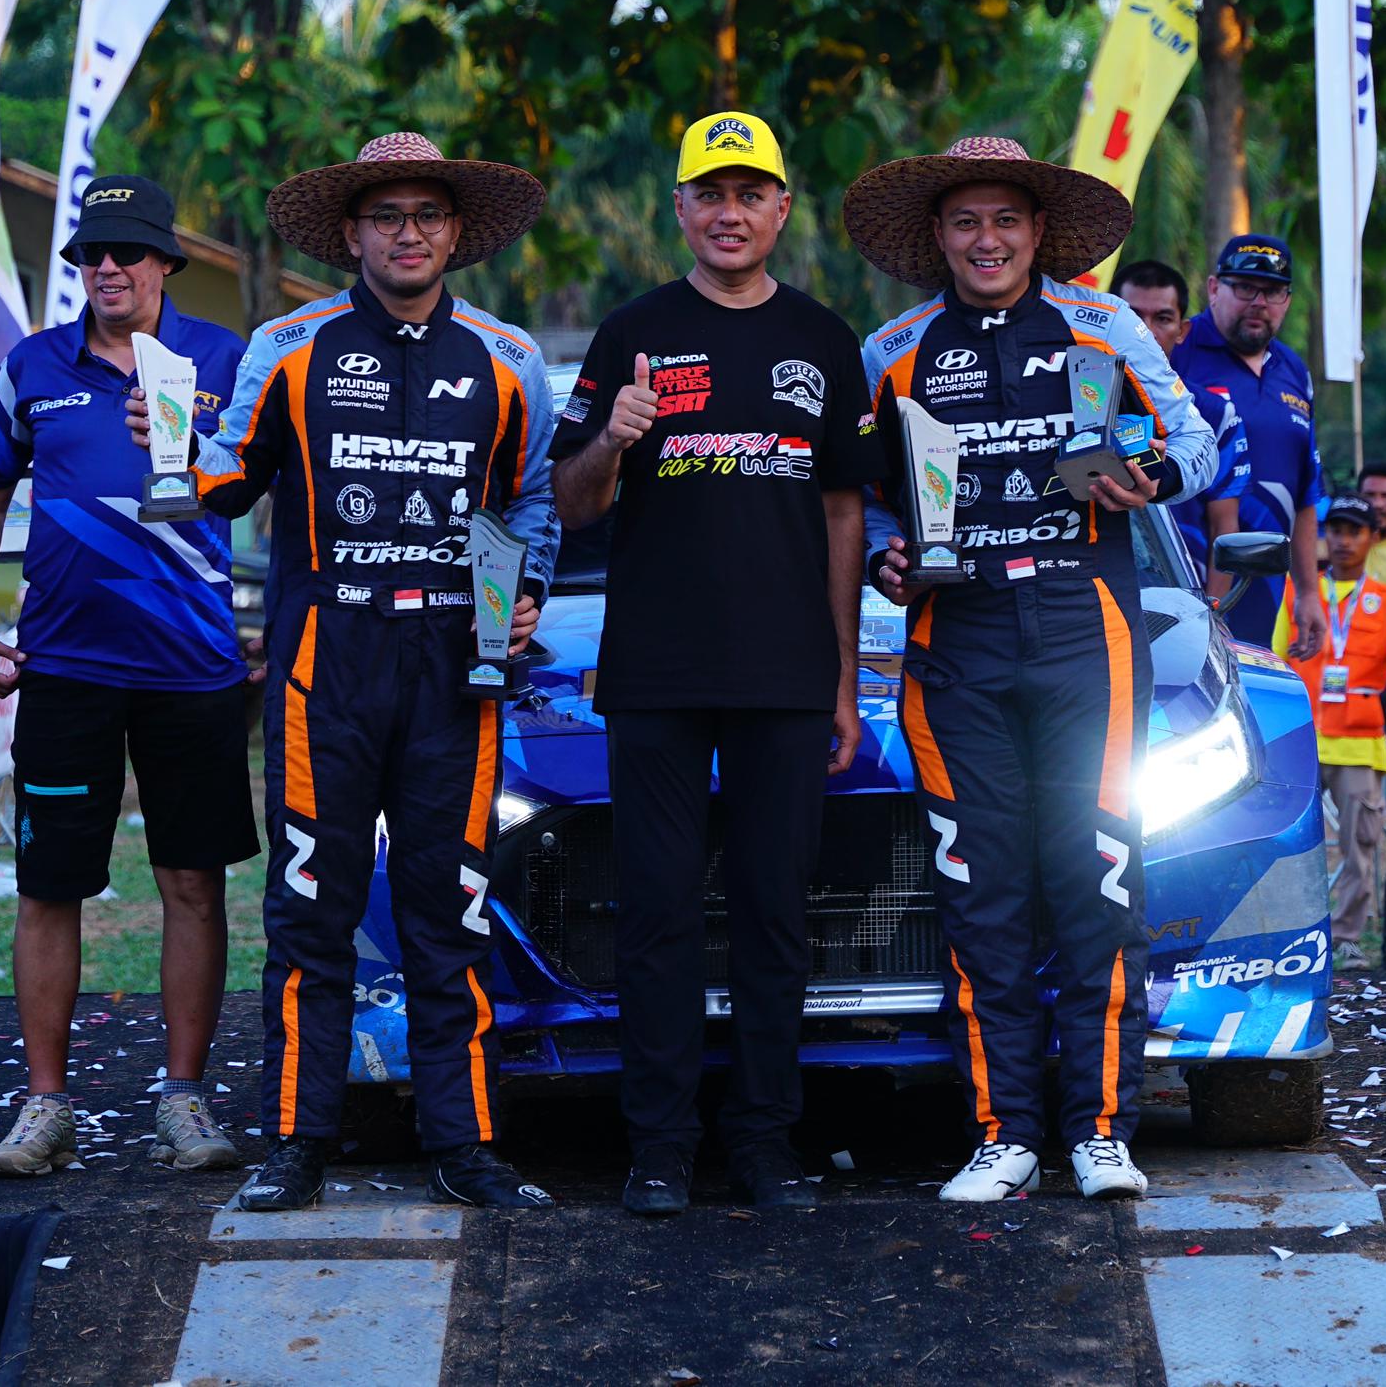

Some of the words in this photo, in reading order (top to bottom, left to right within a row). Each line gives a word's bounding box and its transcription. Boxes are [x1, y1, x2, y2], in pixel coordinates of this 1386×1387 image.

[1075, 308, 1109, 326] OMP
[274, 326, 308, 344] OMP
[883, 329, 914, 352] OMP
[495, 339, 525, 362] OMP
[653, 365, 710, 379] MRF
[925, 370, 988, 387] HYUNDAI
[327, 377, 390, 393] HYUNDAI
[652, 376, 712, 396] TYRES
[926, 380, 988, 396] MOTORSPORT
[327, 389, 390, 402] MOTORSPORT
[656, 391, 712, 417] SRT
[930, 394, 960, 404] Customer
[960, 391, 984, 402] Racing
[331, 400, 362, 410] Customer
[362, 402, 385, 412] Racing
[658, 432, 779, 459] INDONESIA
[657, 456, 706, 478] GOES
[710, 455, 739, 475] TO
[335, 540, 392, 548] PERTAMAX
[336, 587, 372, 602] OMP
[1173, 954, 1237, 974] PERTAMAX
[1173, 951, 1315, 994] TURBO
